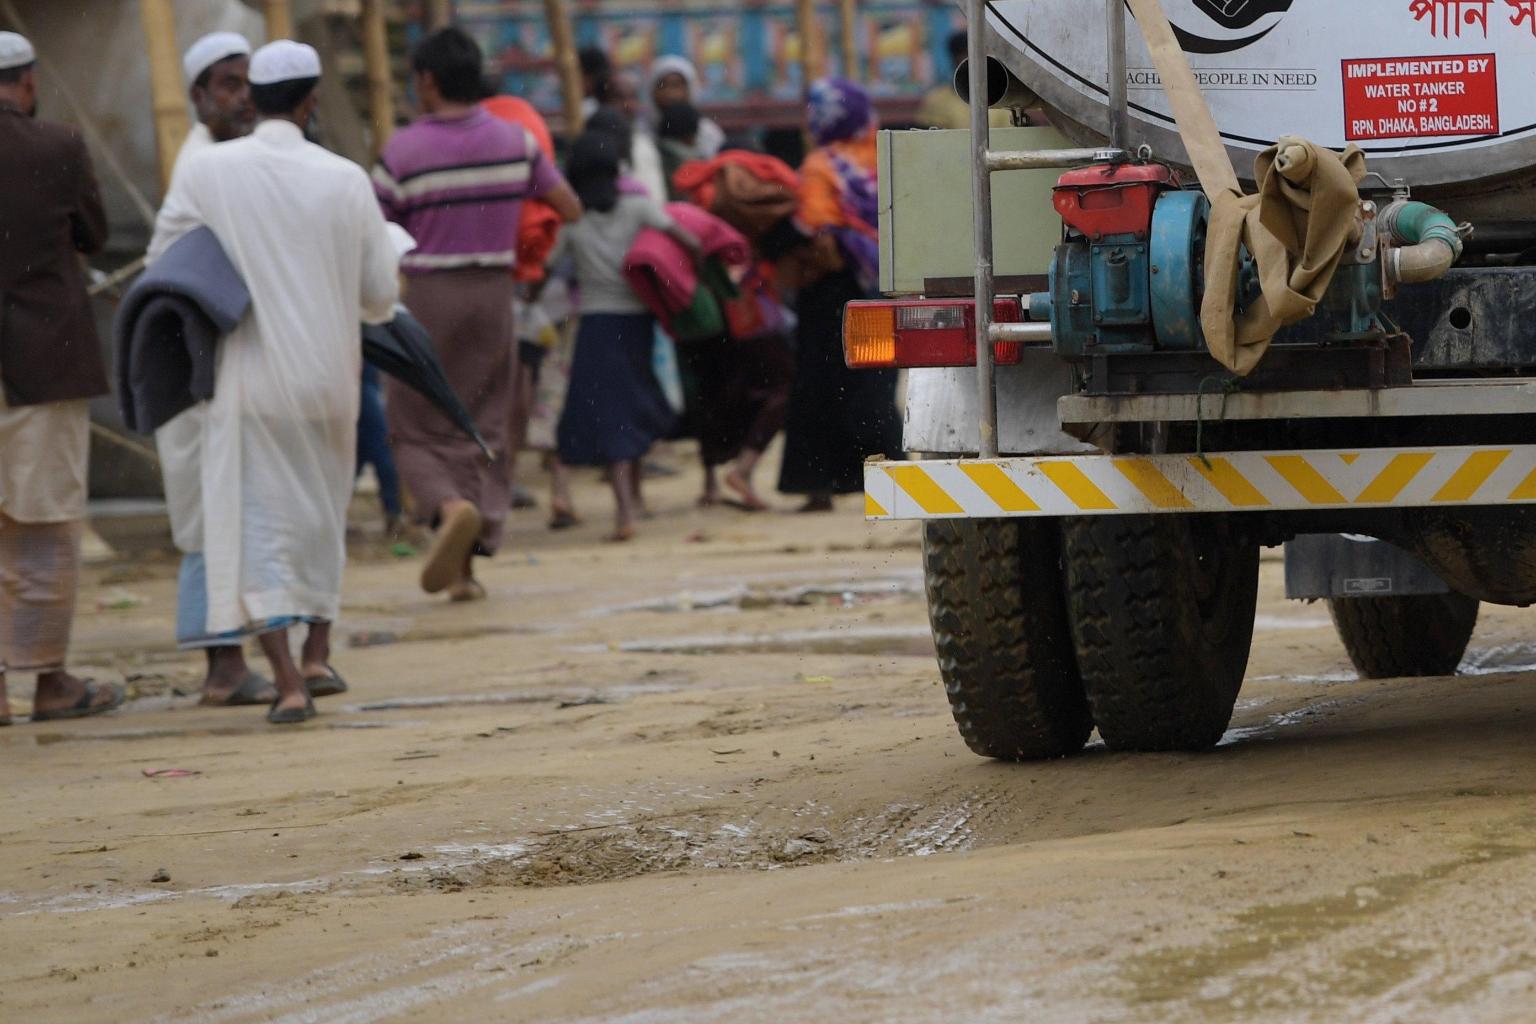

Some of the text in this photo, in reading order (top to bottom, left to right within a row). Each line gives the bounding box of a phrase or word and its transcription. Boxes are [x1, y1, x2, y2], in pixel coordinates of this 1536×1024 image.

[1347, 58, 1489, 79] IMPLEMENTED BY
[1252, 73, 1271, 85] IN
[1273, 73, 1318, 85] NEED
[1364, 81, 1466, 98] WATER TANKER
[1398, 99, 1417, 113] NO
[1352, 114, 1494, 137] RPN, DHAKA, BANGLADESH.
